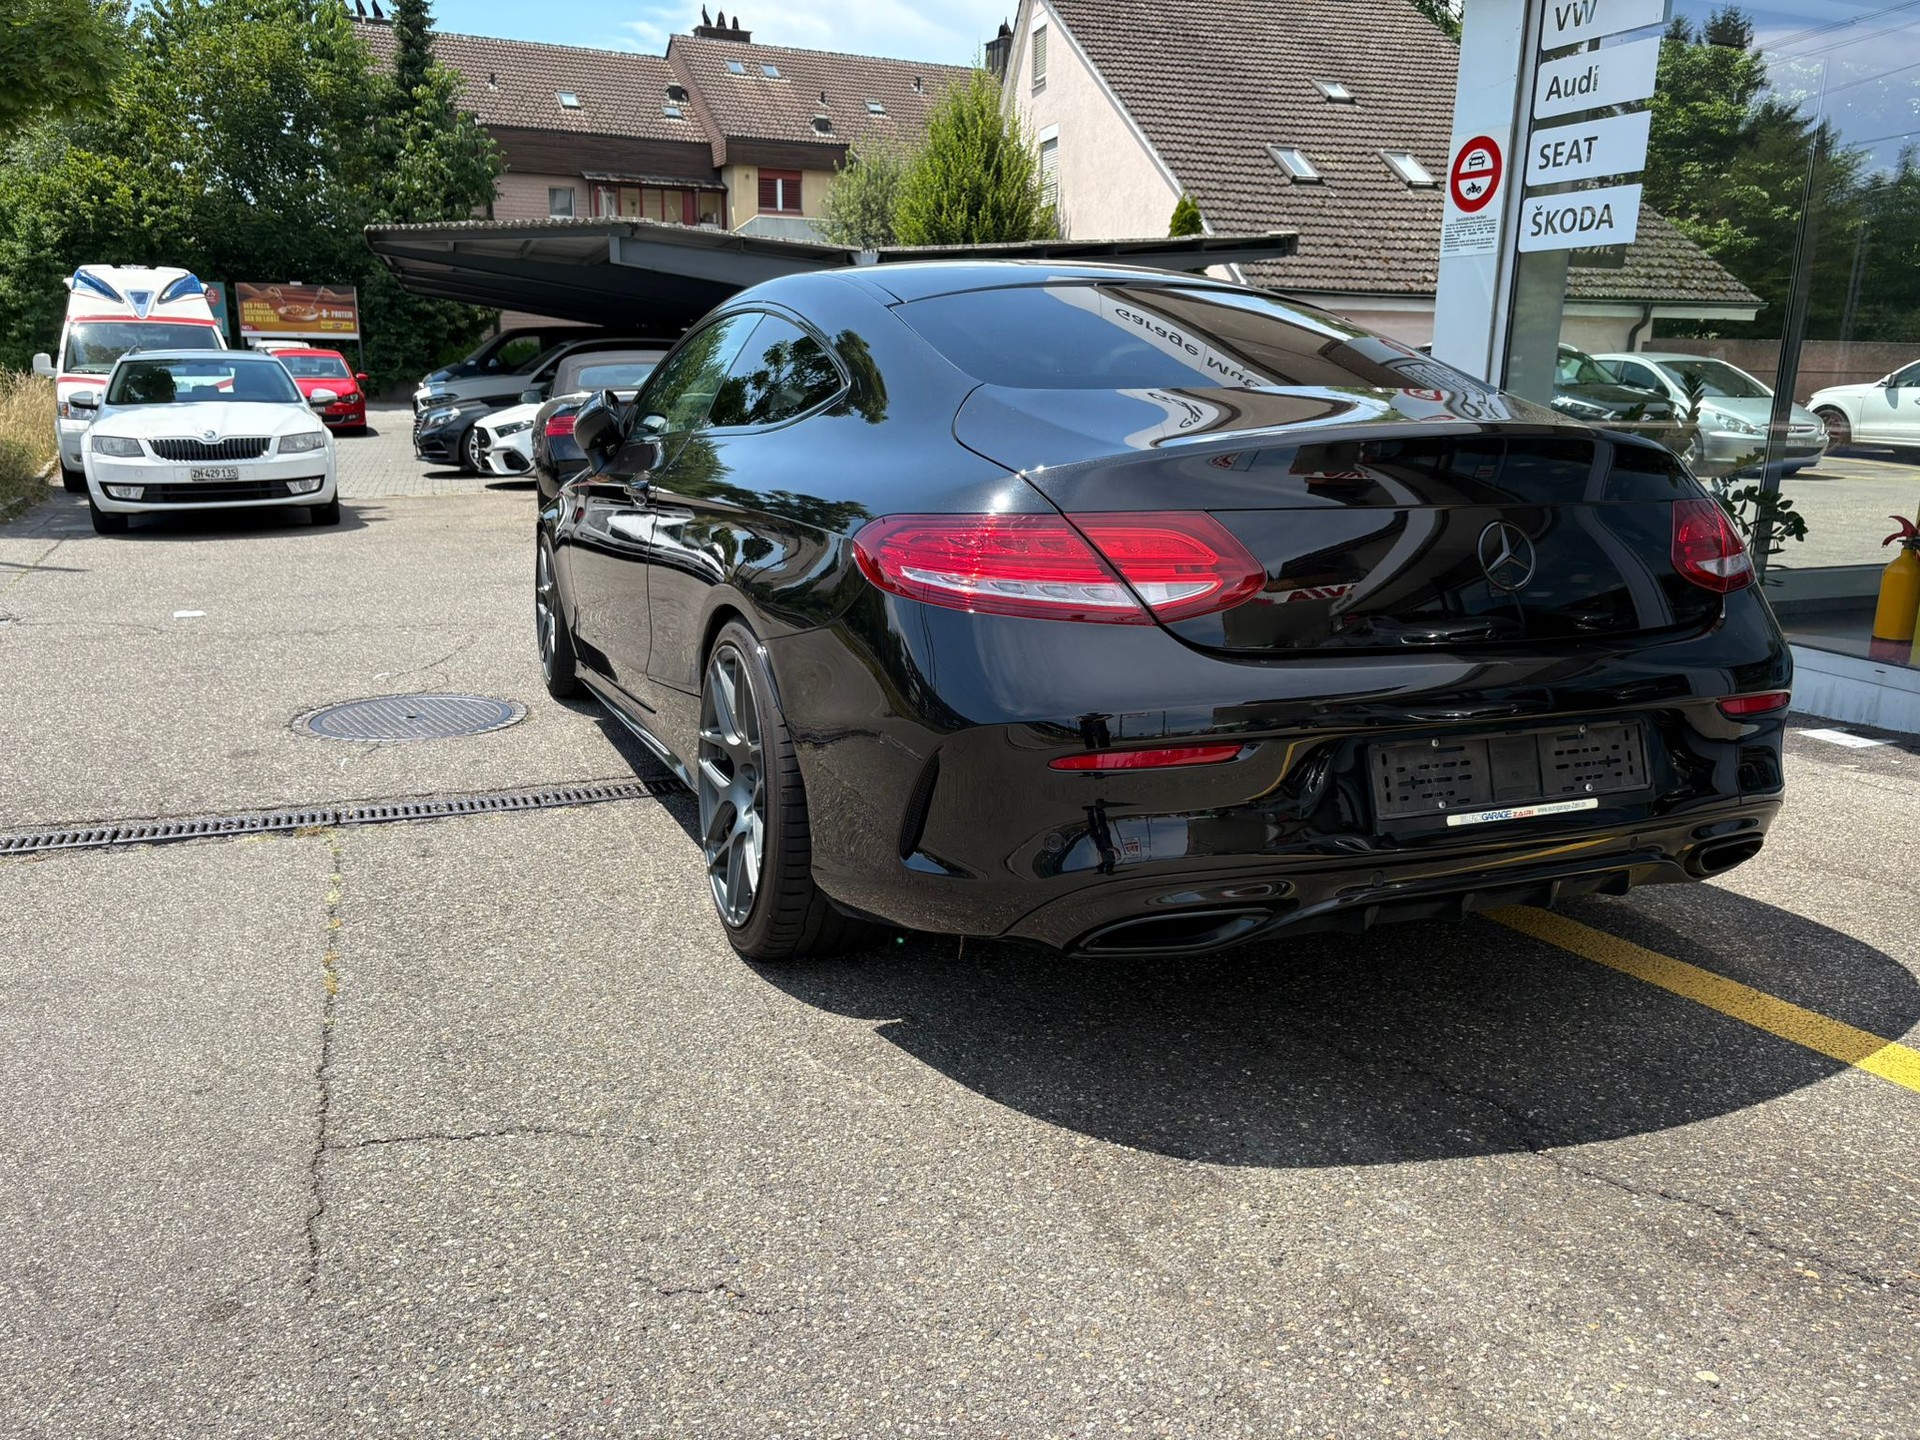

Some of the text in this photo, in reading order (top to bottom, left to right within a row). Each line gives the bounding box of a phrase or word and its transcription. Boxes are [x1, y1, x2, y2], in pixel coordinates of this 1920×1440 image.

[1555, 0, 1598, 31] VW
[1545, 65, 1600, 102] Audi
[1538, 135, 1599, 170] SEAT
[1530, 203, 1614, 237] ŠKODA
[192, 468, 236, 478] ZH 429 135
